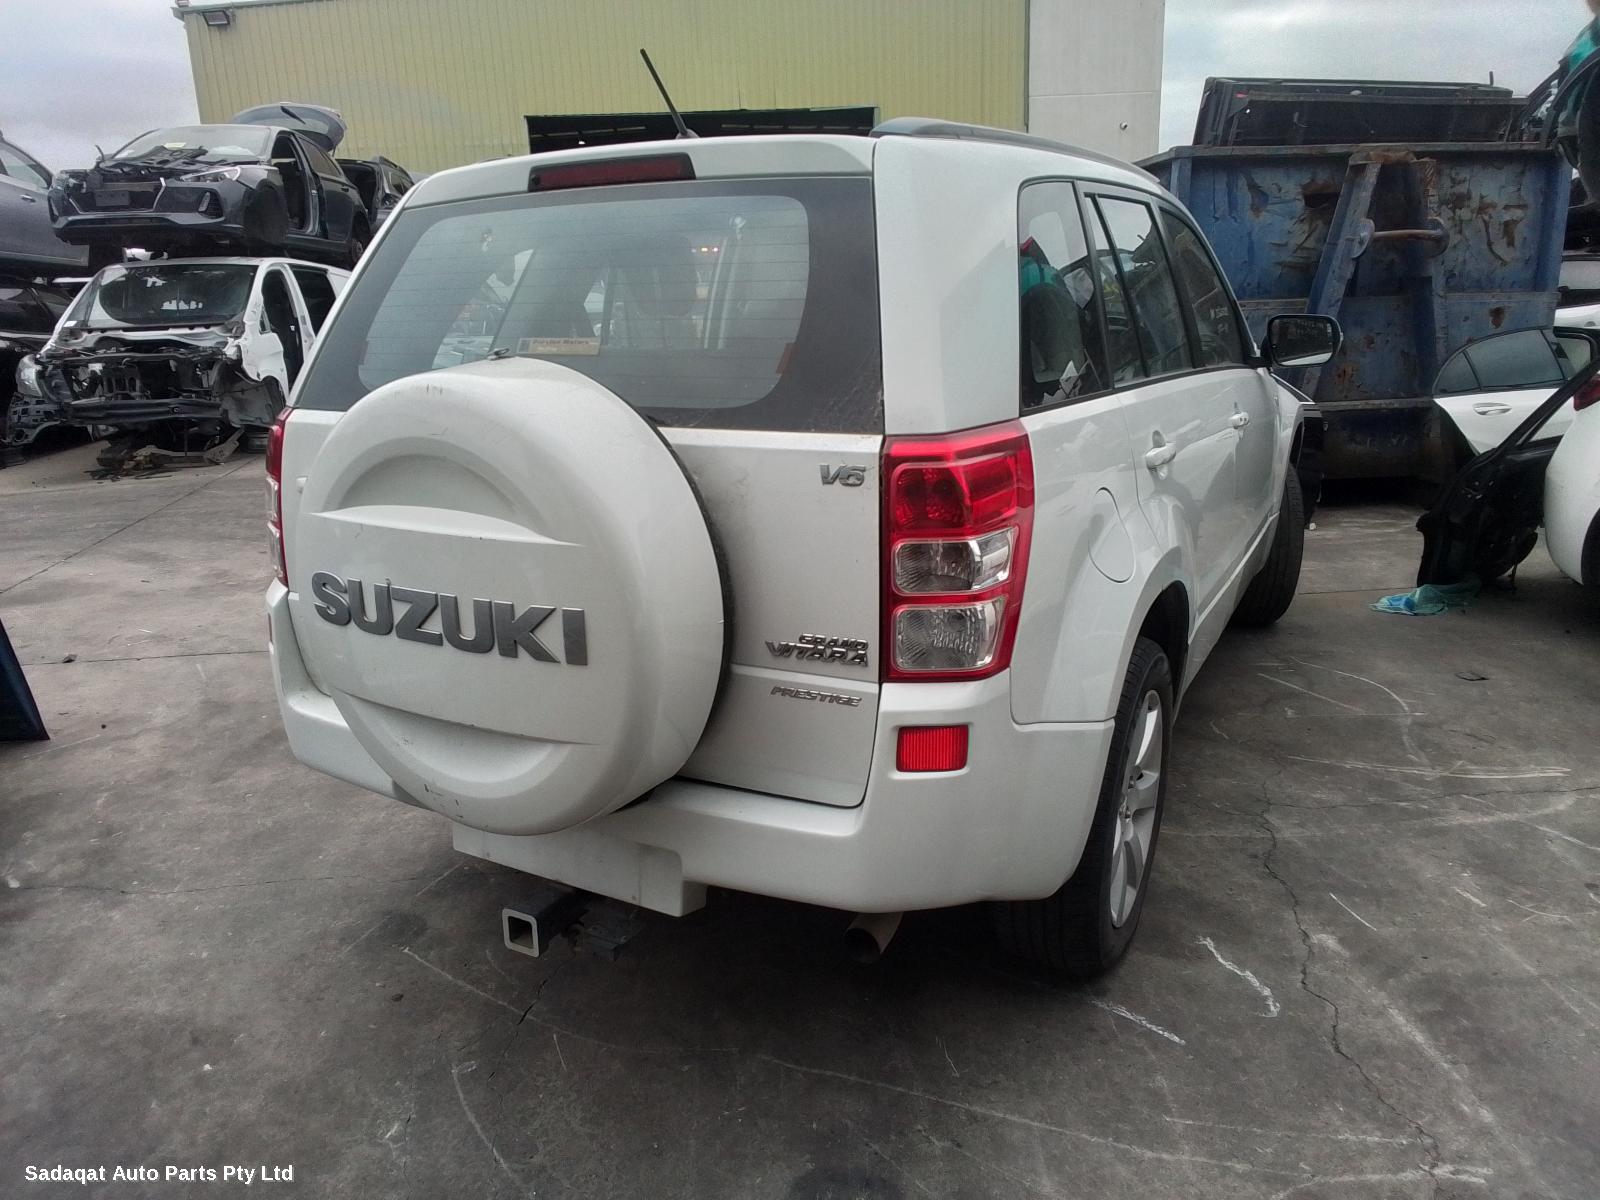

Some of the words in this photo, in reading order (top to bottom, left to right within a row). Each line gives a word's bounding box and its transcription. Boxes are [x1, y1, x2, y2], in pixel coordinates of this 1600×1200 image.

[819, 463, 867, 487] V6
[311, 570, 589, 667] SUZUKI
[764, 640, 869, 668] VITARA
[799, 633, 869, 652] GRAND
[770, 686, 862, 707] PRESTIGE
